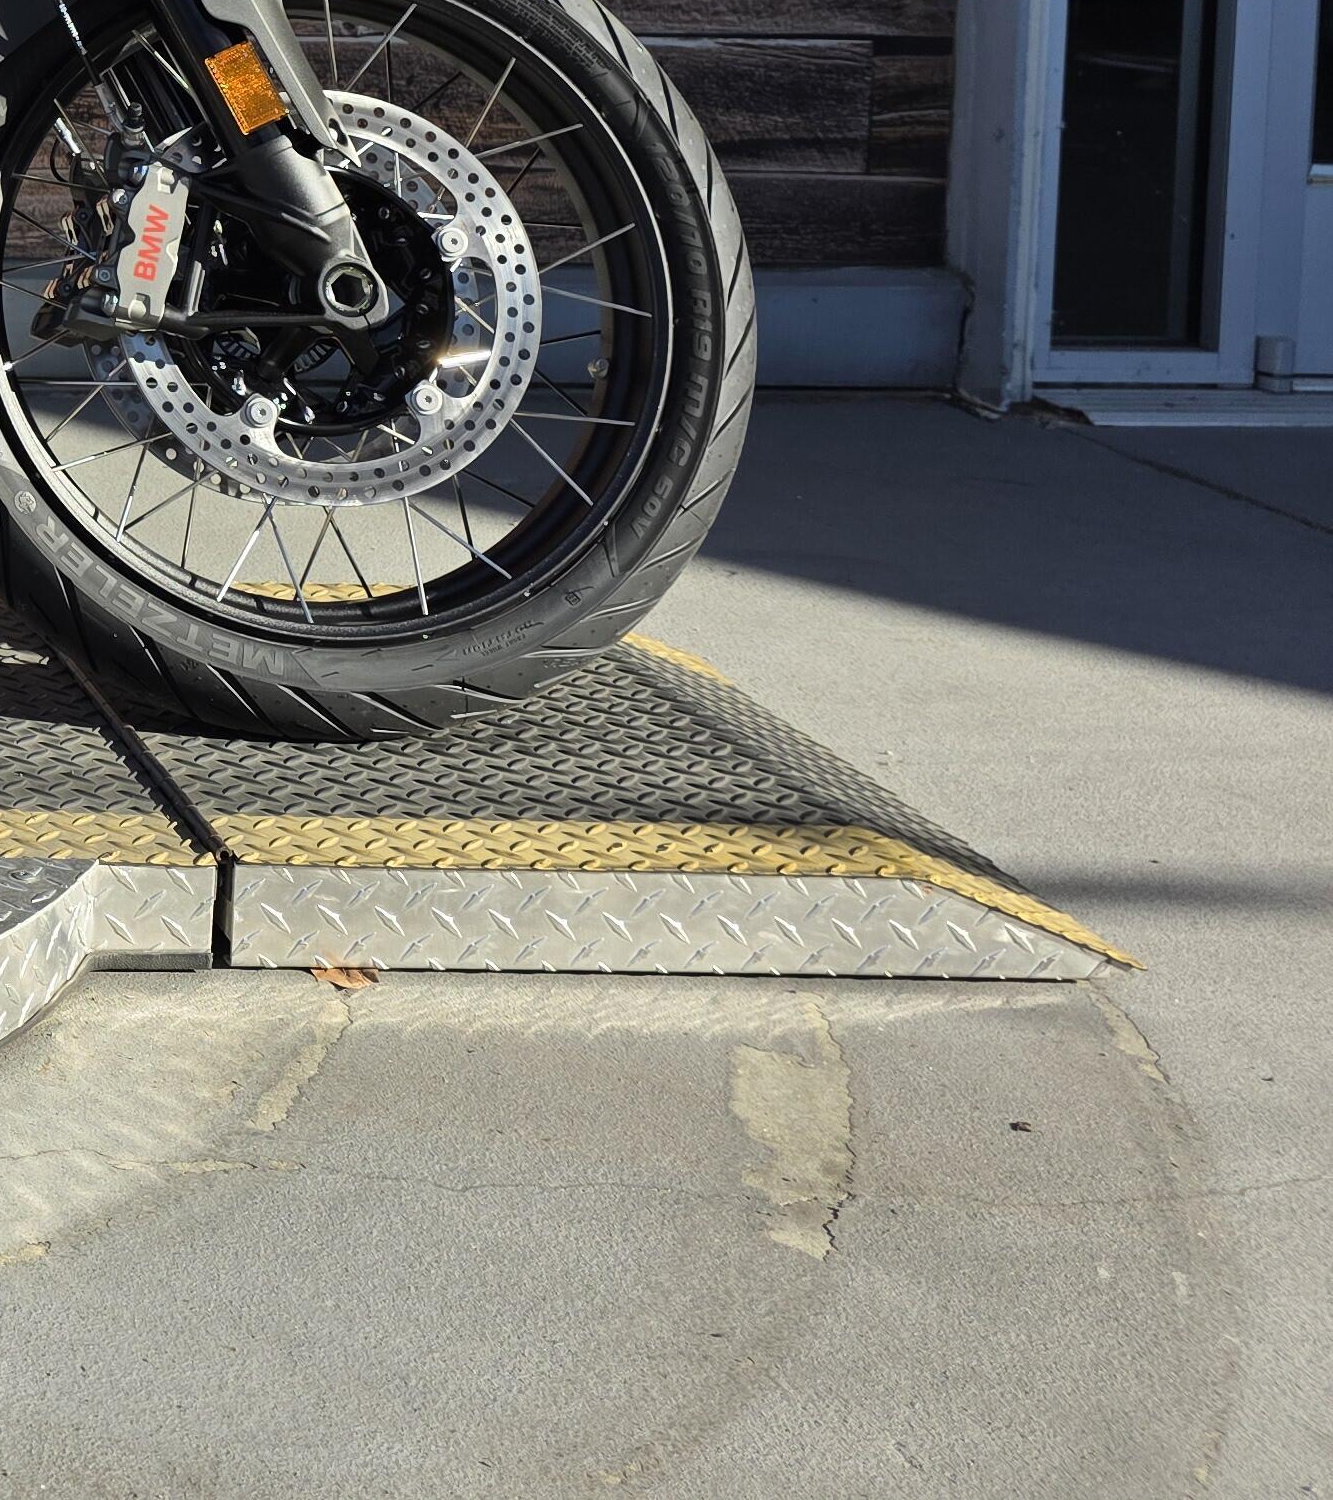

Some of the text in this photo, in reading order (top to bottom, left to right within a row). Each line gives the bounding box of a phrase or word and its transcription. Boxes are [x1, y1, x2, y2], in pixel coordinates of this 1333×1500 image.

[134, 204, 169, 282] BMW
[690, 289, 712, 362] R19
[665, 372, 709, 469] M/C
[625, 472, 675, 540] 60V
[32, 514, 285, 675] METZELER
